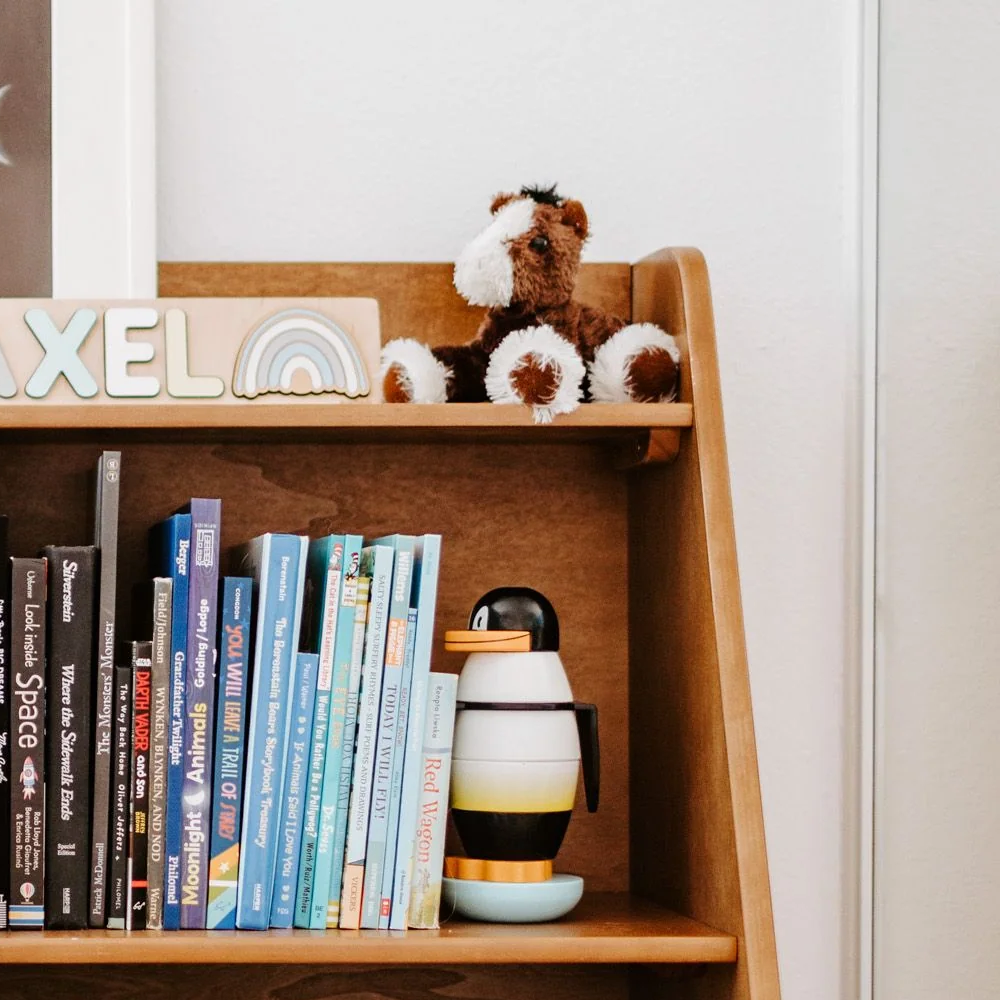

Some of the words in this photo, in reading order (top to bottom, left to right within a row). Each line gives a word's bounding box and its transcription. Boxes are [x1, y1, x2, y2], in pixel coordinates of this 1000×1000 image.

[176, 540, 190, 576] Berger
[26, 570, 36, 599] Usborne
[63, 560, 77, 622] Silverstein
[377, 575, 386, 598] SALTY
[394, 551, 411, 602] Willems
[24, 604, 40, 631] Look
[156, 592, 168, 664] Field/Johnson
[197, 599, 208, 632] Lodge
[275, 618, 287, 637] The
[375, 602, 383, 632] SLEEPY
[24, 635, 38, 667] inside
[100, 622, 114, 668] Monster
[323, 637, 332, 665] Learning
[371, 634, 381, 669] SURFERY
[194, 643, 207, 688] Golding
[226, 663, 242, 697] WILL
[269, 640, 284, 698] Berenstain
[62, 664, 74, 704] Where
[136, 672, 149, 709] DARTH
[173, 651, 184, 718] Grandfather
[367, 672, 377, 706] RHYMES
[15, 672, 43, 748] Space
[62, 707, 74, 727] the
[153, 687, 165, 742] WYNKEN,
[223, 701, 240, 732] LEAVE
[267, 702, 279, 734] Bears
[317, 695, 328, 720] Would
[365, 713, 373, 732] SURF
[382, 685, 398, 733] TODAY
[97, 732, 110, 755] The
[135, 714, 148, 751] VADER
[169, 719, 182, 765] Twilight
[186, 703, 207, 784] Animals
[294, 742, 304, 751] If
[315, 724, 326, 739] You
[61, 730, 76, 785] Sidewalk
[136, 755, 147, 777] and
[221, 748, 239, 779] TRAIL
[261, 737, 276, 794] Storybook
[312, 743, 323, 770] Rather
[362, 736, 370, 765] POEMS
[377, 745, 391, 783] WILL
[152, 745, 163, 803] BLYNKEN,
[290, 754, 302, 794] Animals
[312, 773, 321, 783] Be
[360, 766, 369, 785] AND
[423, 758, 442, 793] Red
[61, 788, 73, 820] Ends
[117, 784, 125, 812] Oliver
[221, 782, 237, 799] OF
[374, 789, 388, 819] FLY!
[153, 805, 162, 831] AND
[219, 802, 236, 841] STARS
[255, 797, 273, 848] Treasury
[288, 796, 298, 818] Said
[305, 795, 318, 837] Pollywog?
[356, 786, 366, 831] DRAWINGS
[32, 827, 40, 847] Lloyd
[116, 816, 124, 851] Jeffers
[285, 829, 296, 854] Love
[319, 824, 332, 853] Seuss
[417, 800, 439, 863] Wagon
[32, 849, 40, 870] Jones,
[95, 843, 104, 884] McDonnell
[151, 835, 162, 861] NOD
[182, 811, 204, 905] Moonlight
[167, 856, 178, 905] Philomel
[282, 857, 292, 877] You
[93, 888, 102, 914] Patrick
[150, 888, 160, 920] Warne
[254, 884, 262, 911] HARPER
[349, 877, 358, 912] VICKERS
